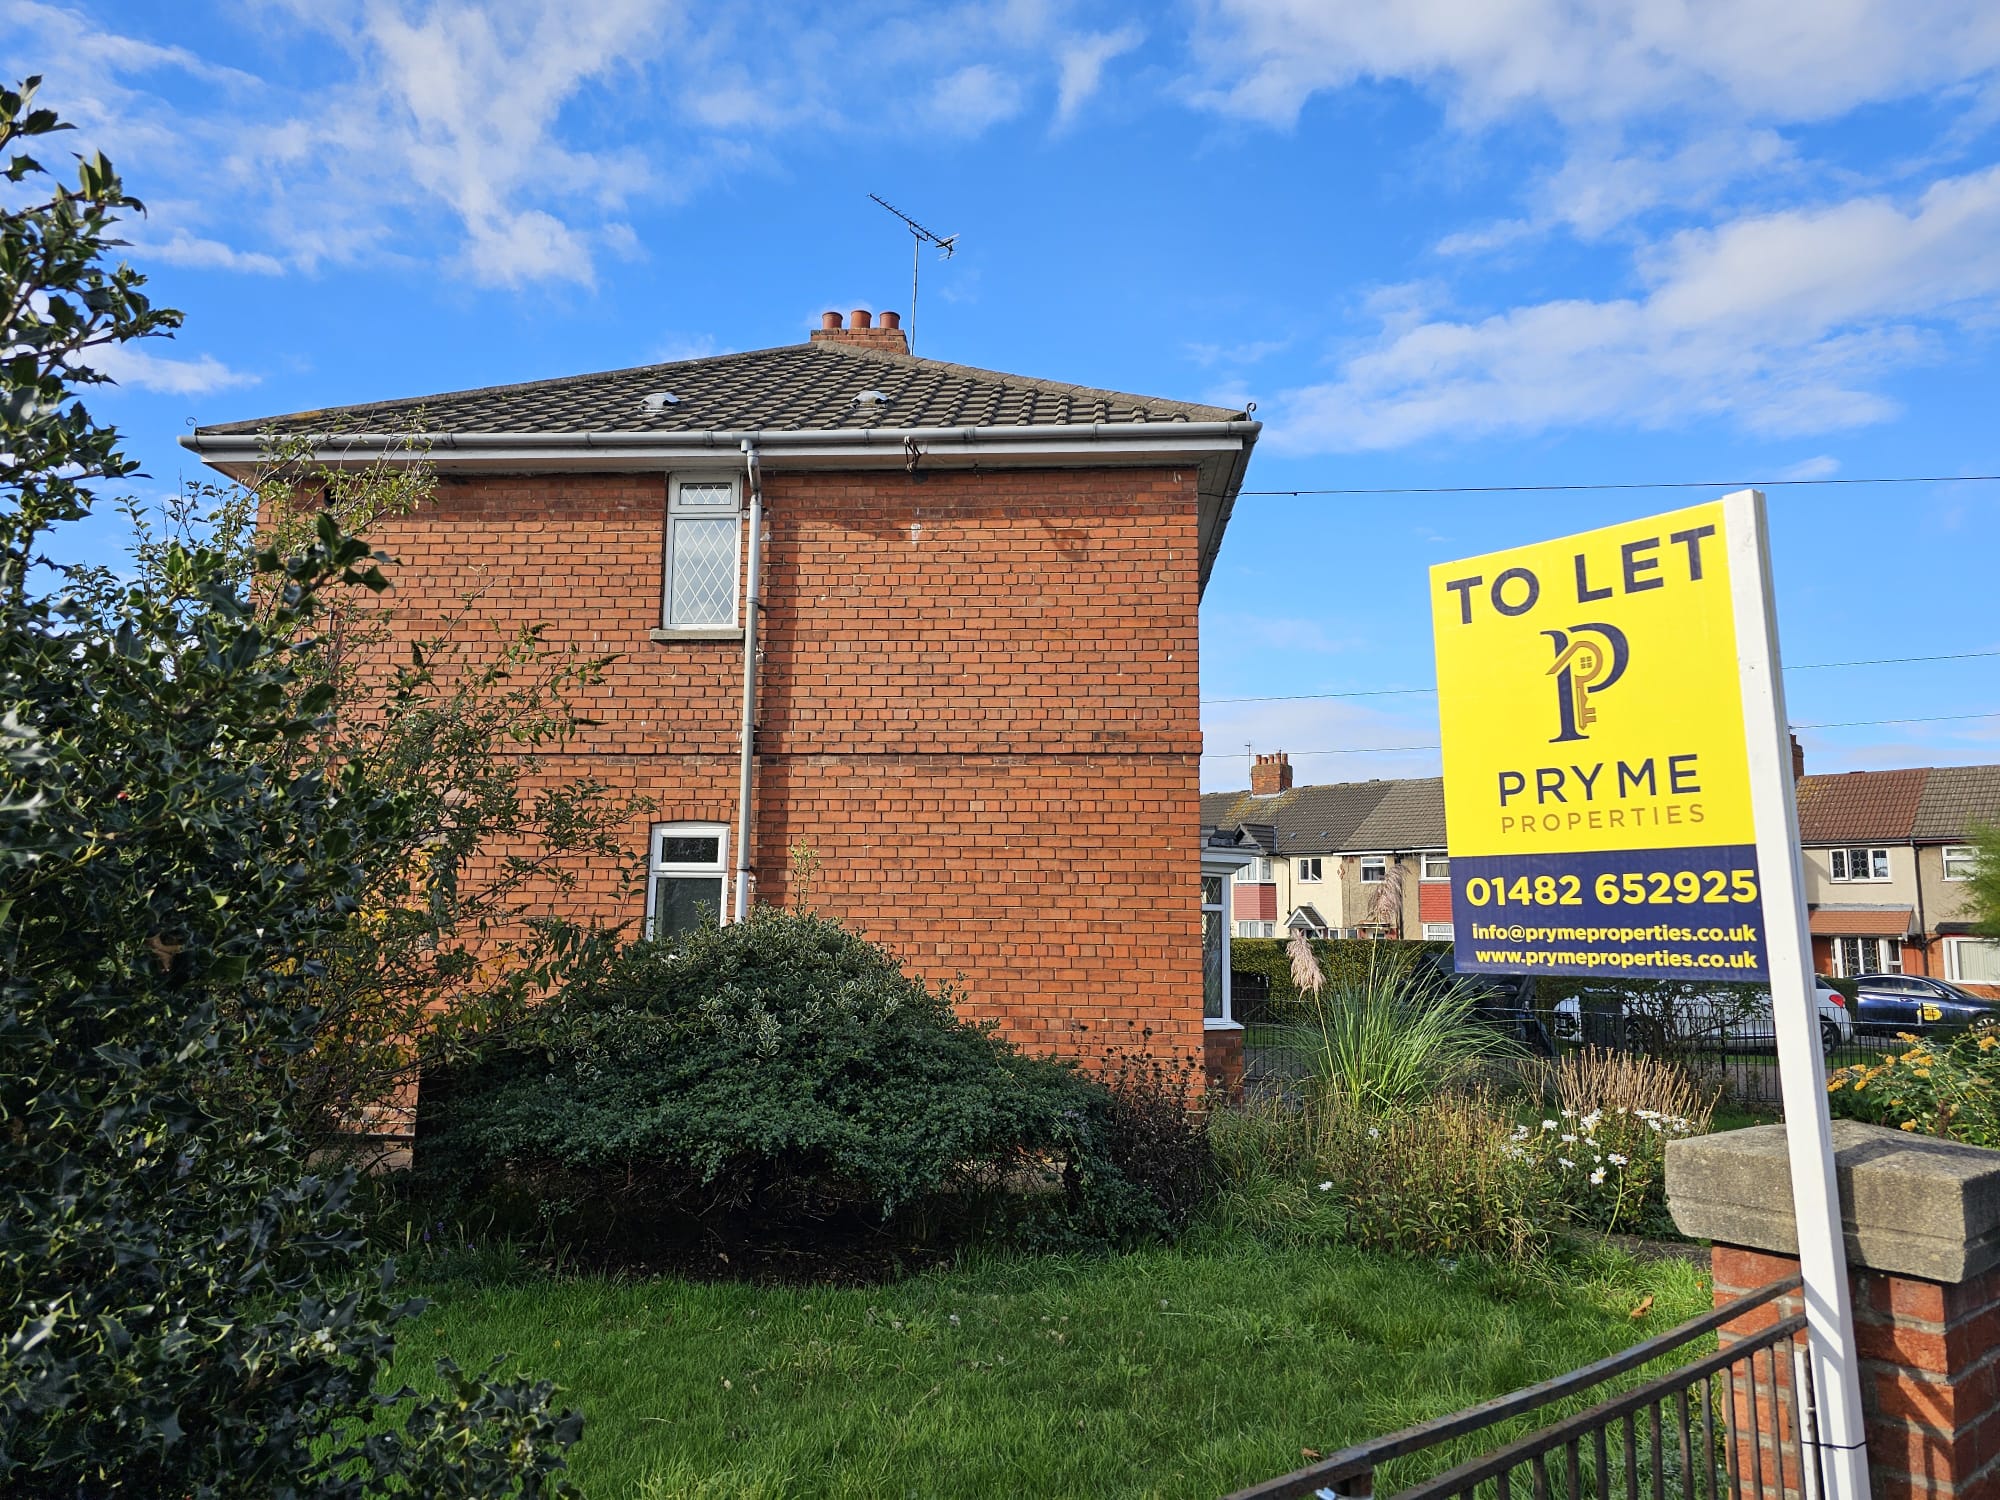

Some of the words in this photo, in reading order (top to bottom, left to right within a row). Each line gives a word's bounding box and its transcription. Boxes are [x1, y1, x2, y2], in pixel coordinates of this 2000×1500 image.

[1446, 567, 1540, 624] TO
[1574, 524, 1715, 603] LET
[1498, 754, 1701, 807] PRYME
[1501, 804, 1705, 834] PROPERTIES
[1465, 875, 1584, 906] 01482
[1594, 869, 1758, 904] 652925
[1472, 923, 1757, 944] info@prymeproperties.co.uk
[1476, 949, 1758, 969] www.prymeproperties.co.uk
